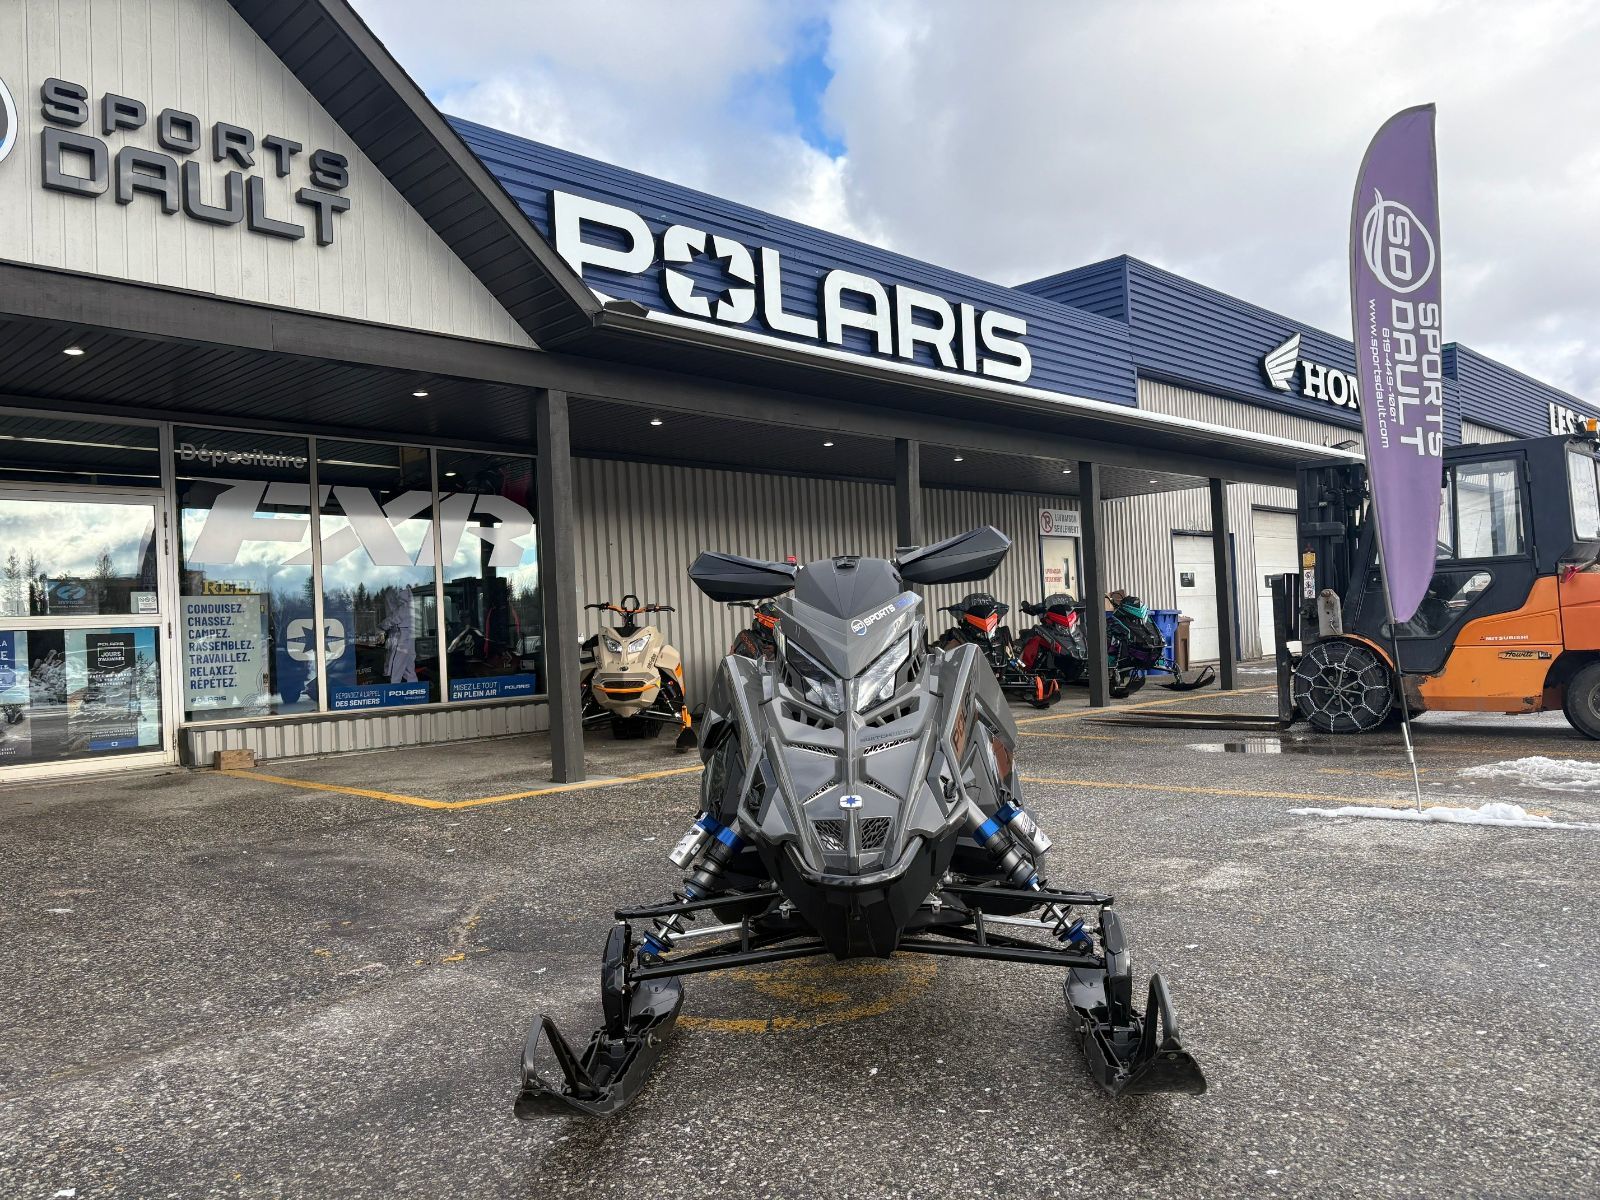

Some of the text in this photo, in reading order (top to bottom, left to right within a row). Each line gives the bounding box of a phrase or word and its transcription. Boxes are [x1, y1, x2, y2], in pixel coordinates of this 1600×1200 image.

[41, 78, 349, 191] SPORTS
[41, 126, 350, 247] DAULT
[548, 189, 1032, 382] POLARIS
[1368, 298, 1390, 448] www.sportsdault.com
[1391, 298, 1425, 456] DAULT
[1418, 302, 1443, 457] SPORTS
[180, 442, 305, 470] Dépositaire
[187, 477, 535, 568] FXR
[187, 604, 245, 614] CONDUISEZ.
[863, 603, 896, 627] SPORTS
[187, 616, 235, 627] CHASSEZ.
[188, 628, 231, 639] CAMPEZ.
[188, 640, 255, 652] RASSEMBLEZ.
[189, 652, 251, 664] TRAVAILLEZ.
[190, 666, 237, 677] RELAXEZ.
[190, 676, 237, 690] RÉPÉTEZ.
[472, 682, 481, 690] LE
[481, 681, 498, 689] TOUT
[388, 688, 427, 697] POLARIS
[463, 690, 484, 698] PLEIN
[485, 689, 497, 697] AIR
[335, 698, 381, 708] DES SENTIERS
